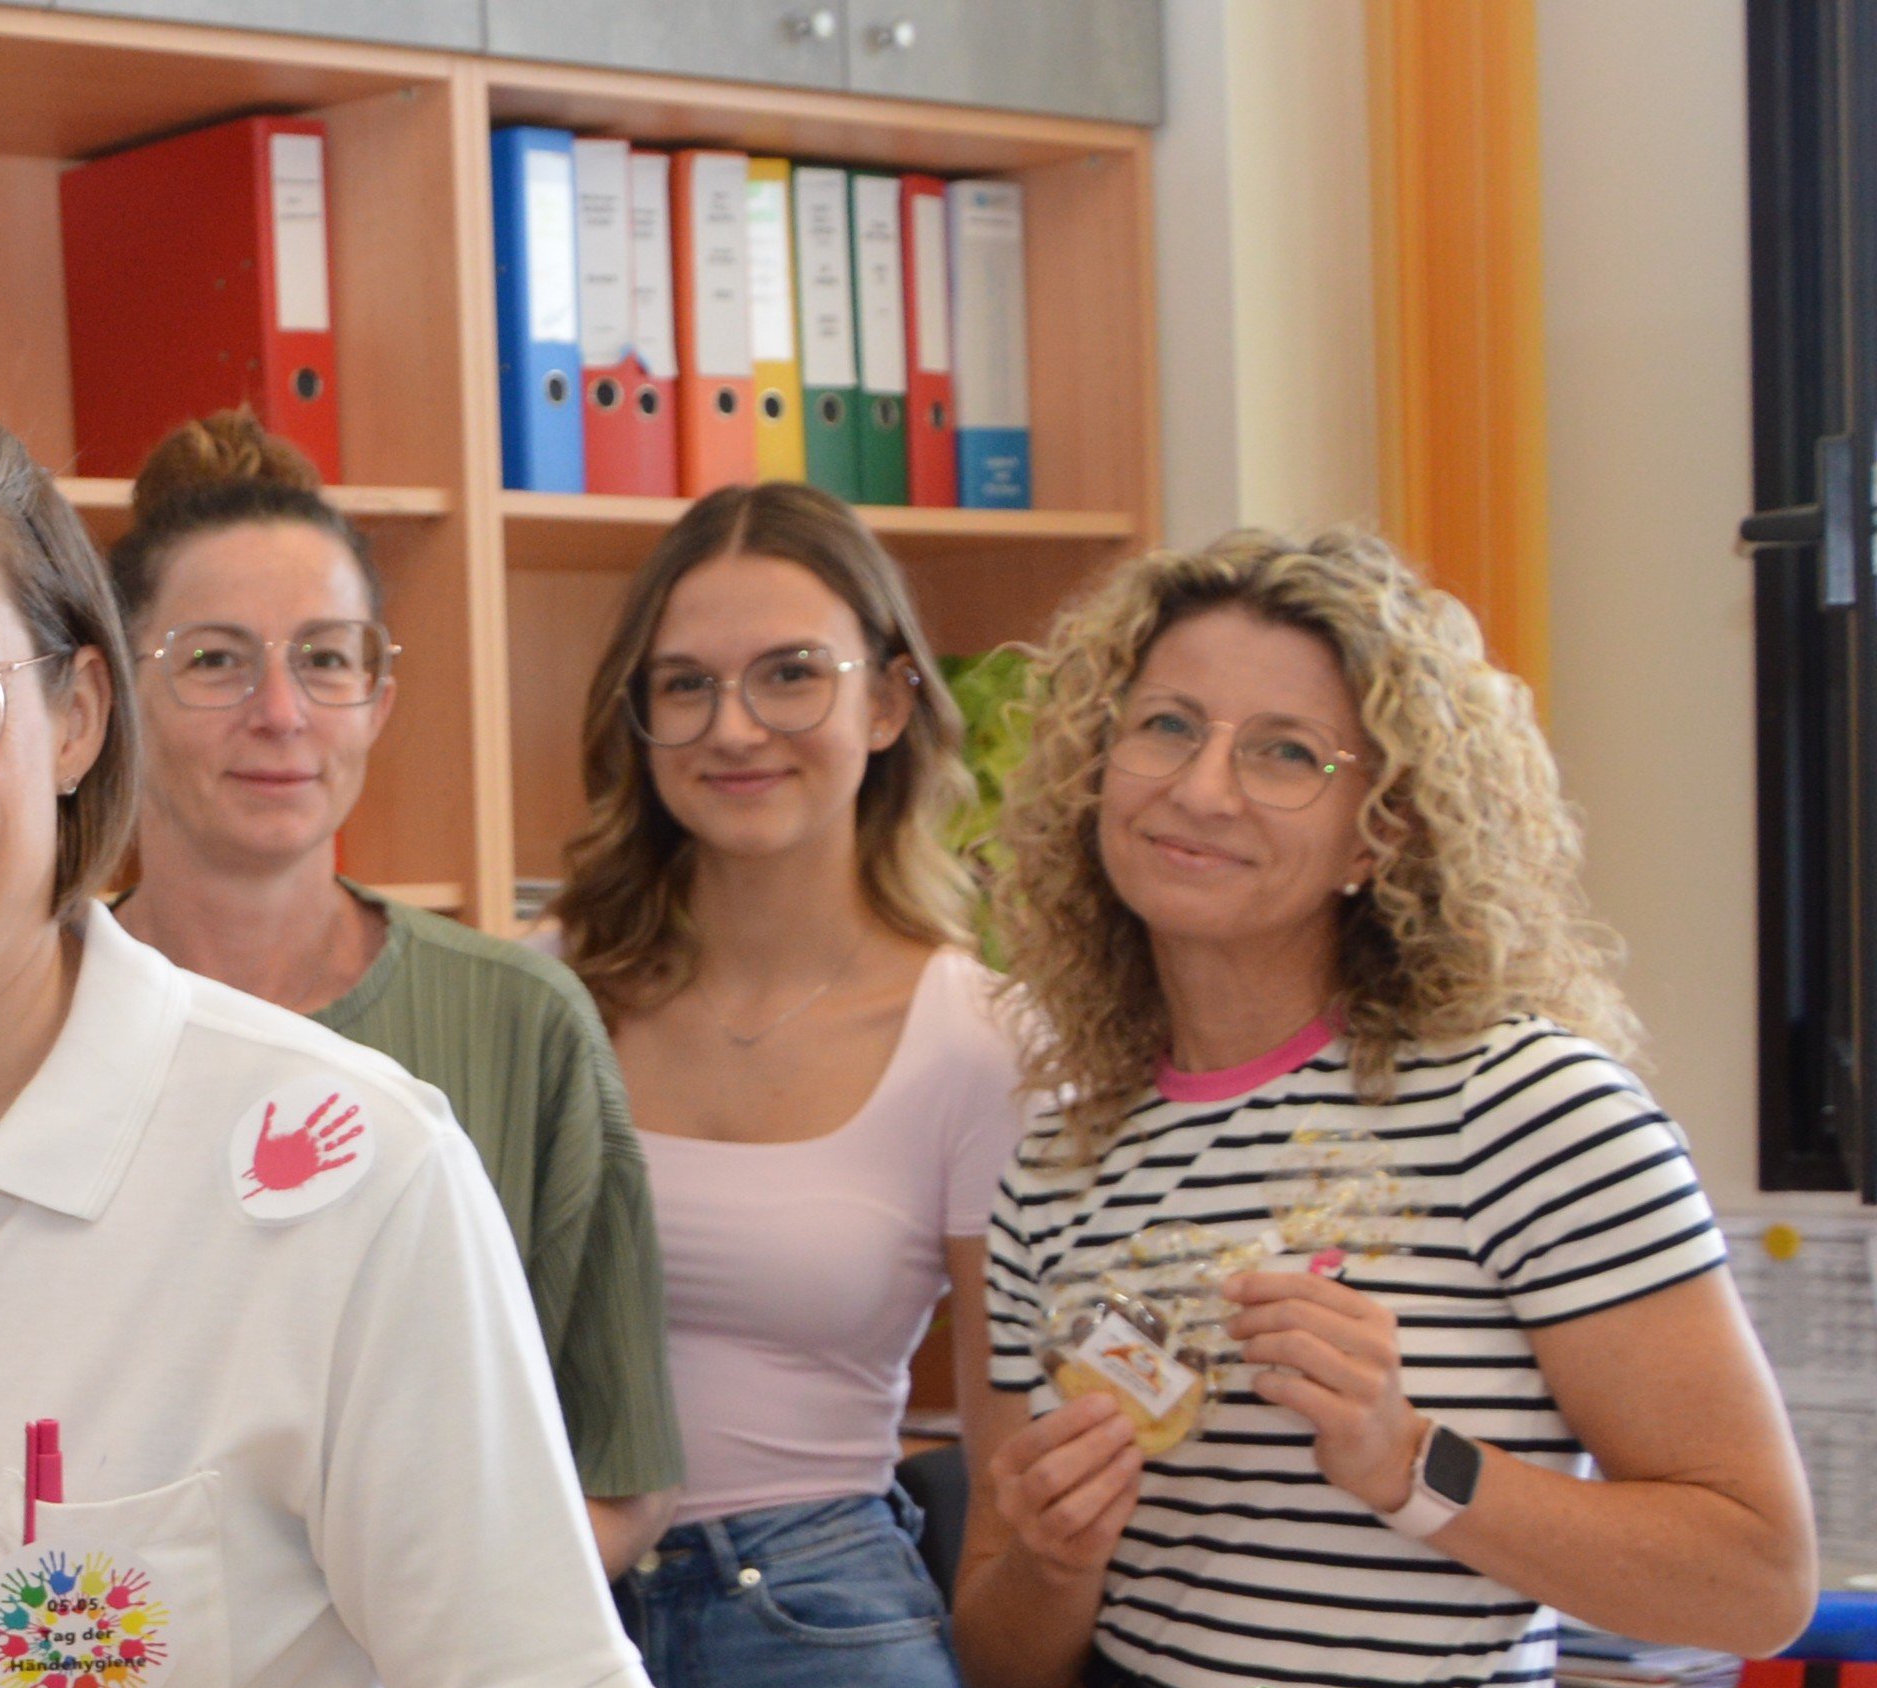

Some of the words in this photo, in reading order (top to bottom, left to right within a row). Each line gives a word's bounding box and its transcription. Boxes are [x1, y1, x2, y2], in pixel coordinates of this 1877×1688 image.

[47, 1598, 105, 1612] 05.05.
[82, 1627, 115, 1640] der
[11, 1656, 147, 1673] Händehygiene
